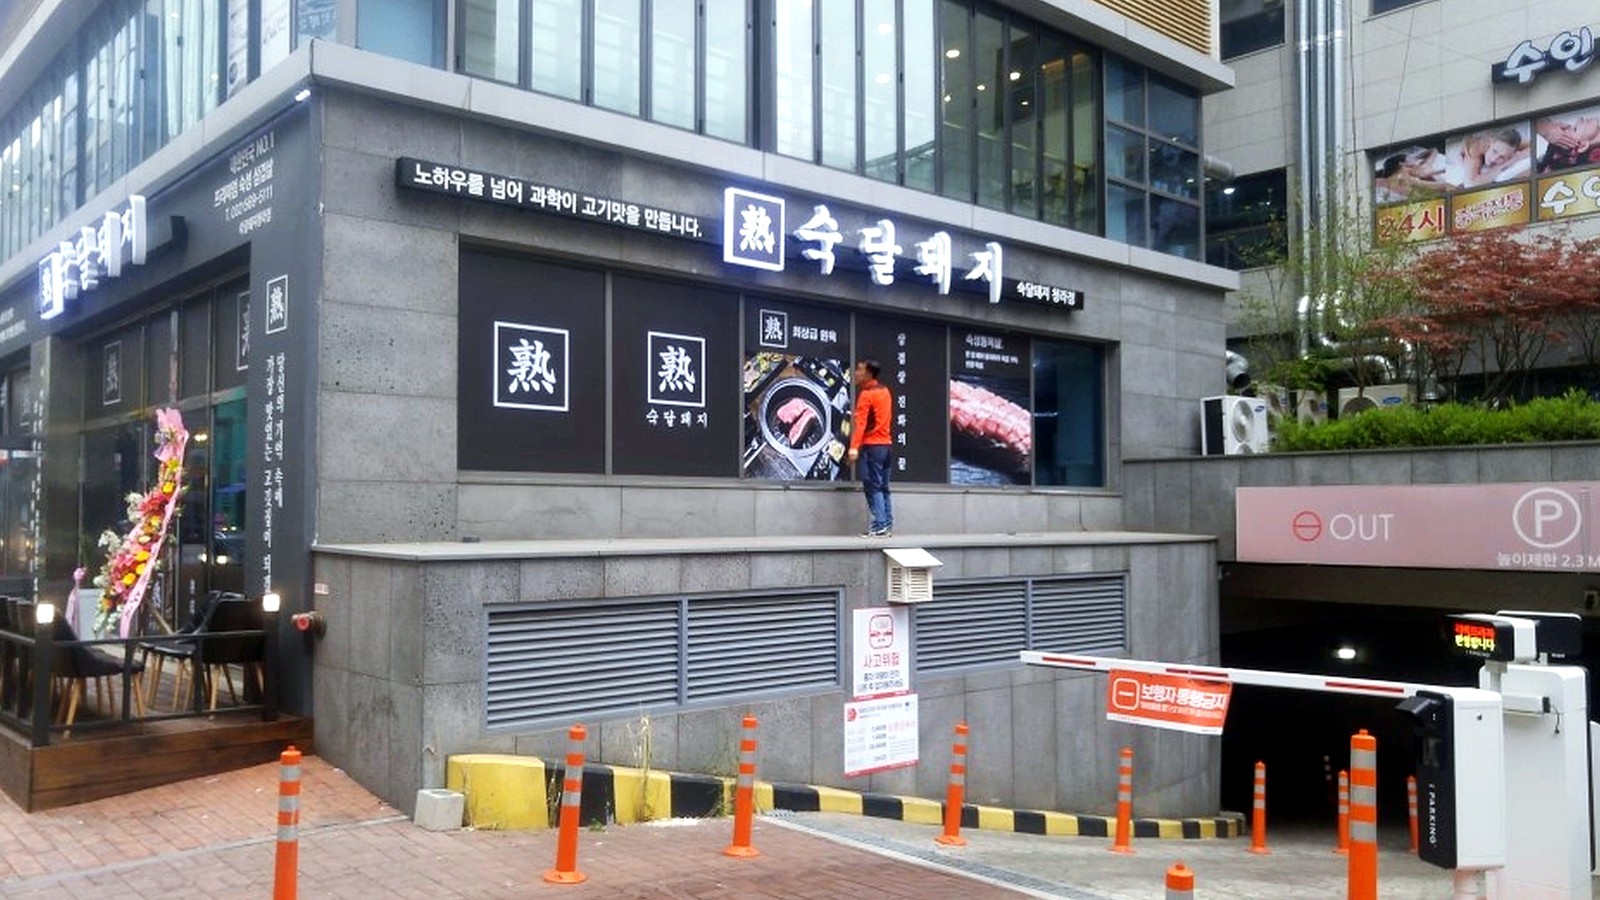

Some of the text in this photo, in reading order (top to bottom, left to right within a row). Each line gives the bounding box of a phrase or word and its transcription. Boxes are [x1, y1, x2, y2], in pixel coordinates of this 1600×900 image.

[413, 164, 703, 238] 노하우를 넘어 과학이 고기맛을 만듭니다.
[793, 205, 1003, 303] 숙달돼지
[507, 338, 557, 394] 熟
[658, 345, 696, 393] 熟
[645, 408, 709, 429] 숙달돼지
[1328, 513, 1395, 542] OUT
[1534, 499, 1563, 538] P
[1497, 552, 1557, 568] 높이제한
[1561, 554, 1585, 568] 2.3
[863, 652, 901, 669] 사고위험
[1141, 684, 1177, 702] 보행자
